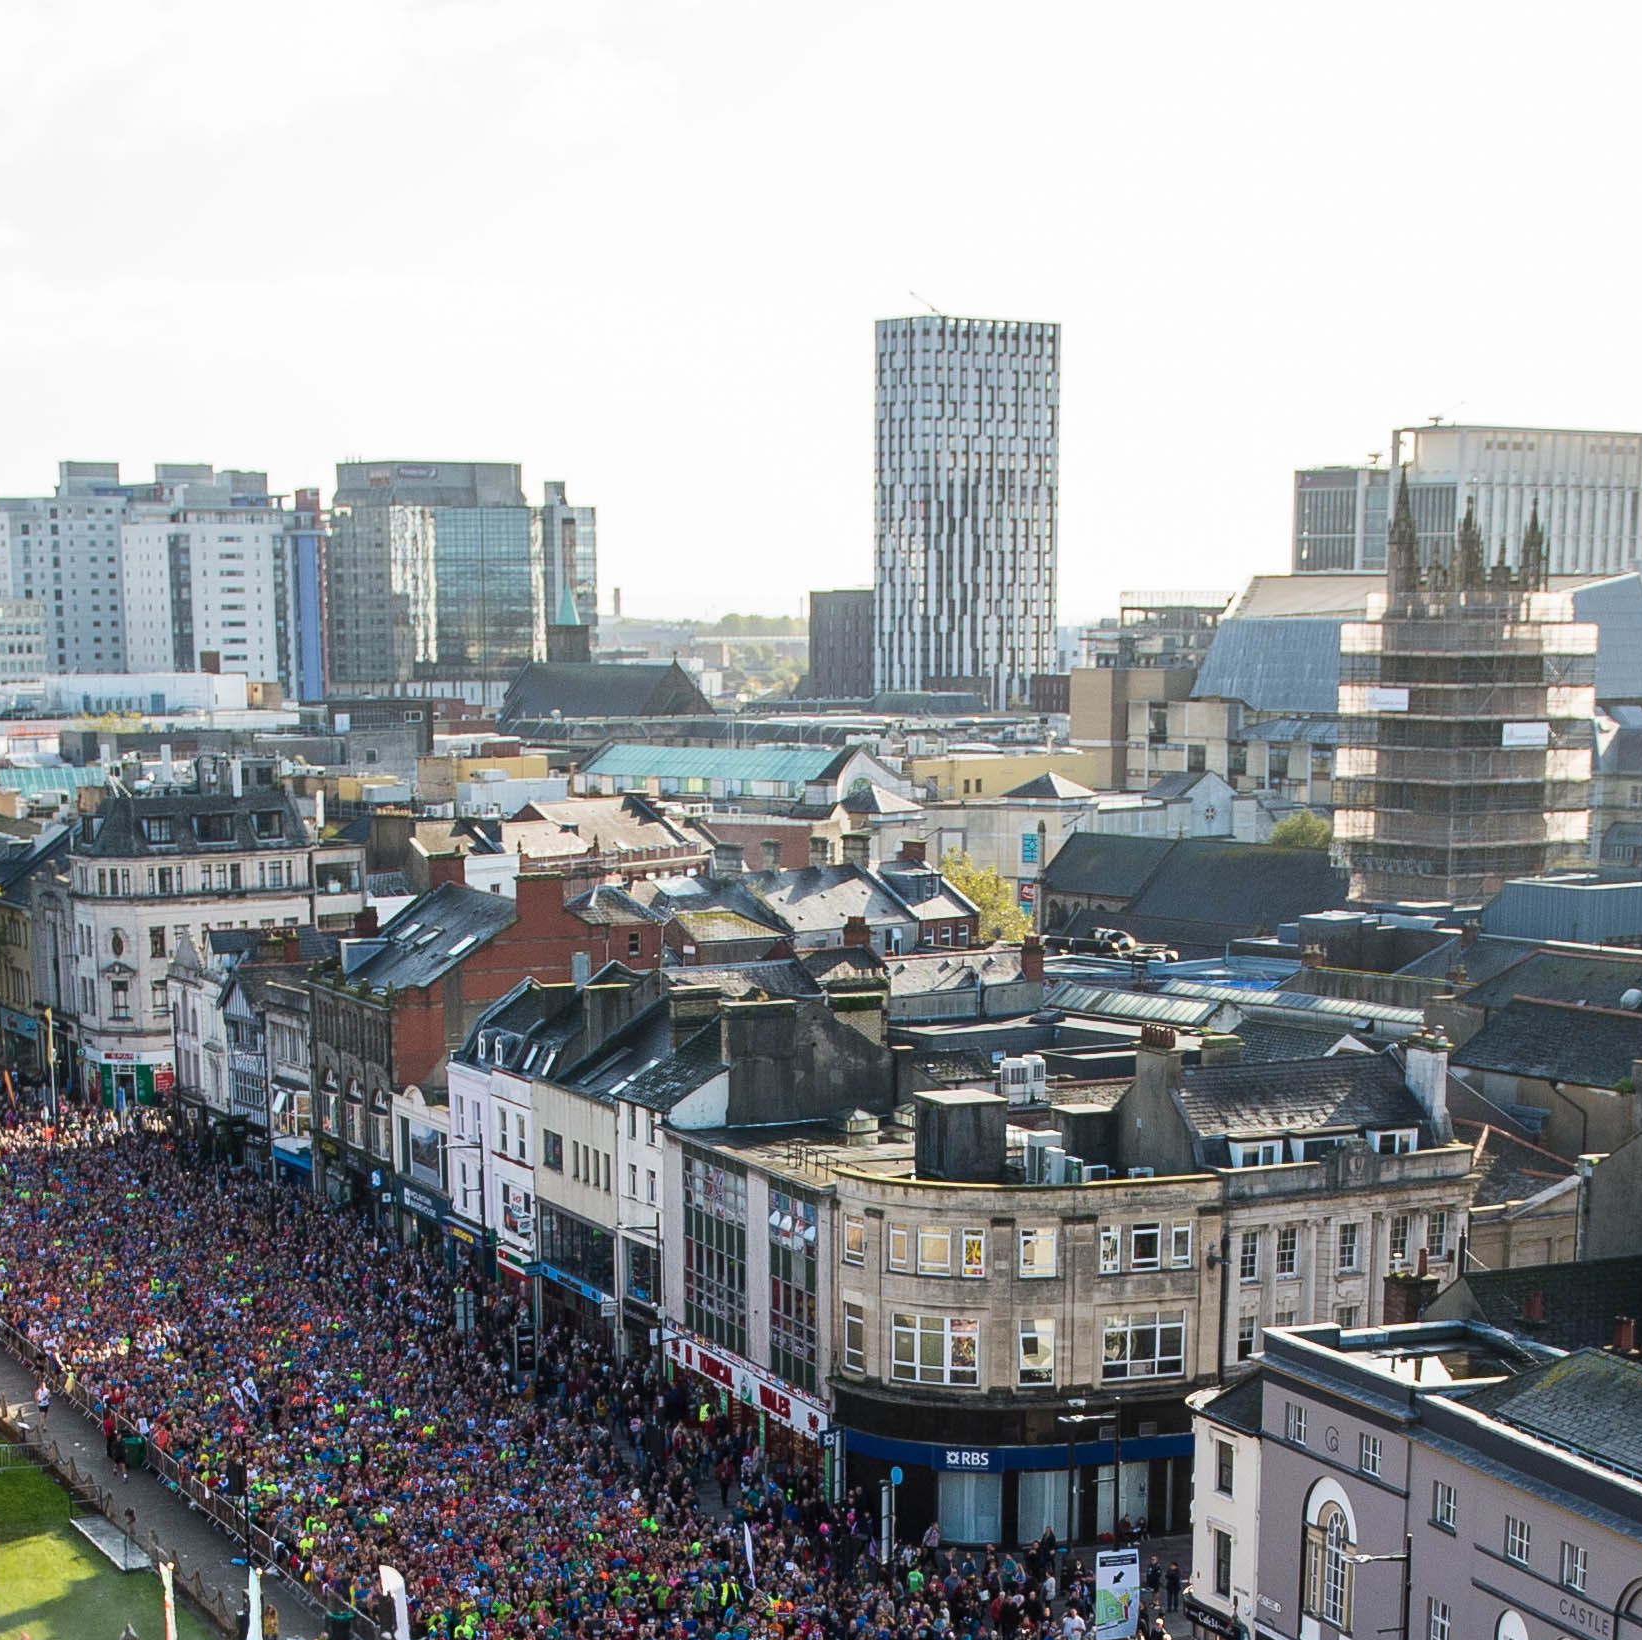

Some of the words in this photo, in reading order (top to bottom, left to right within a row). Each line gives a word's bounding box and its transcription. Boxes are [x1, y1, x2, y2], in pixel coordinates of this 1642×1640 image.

[759, 1384, 791, 1420] WALES
[961, 1451, 989, 1466] RBS
[1559, 1597, 1610, 1637] CASTLE
